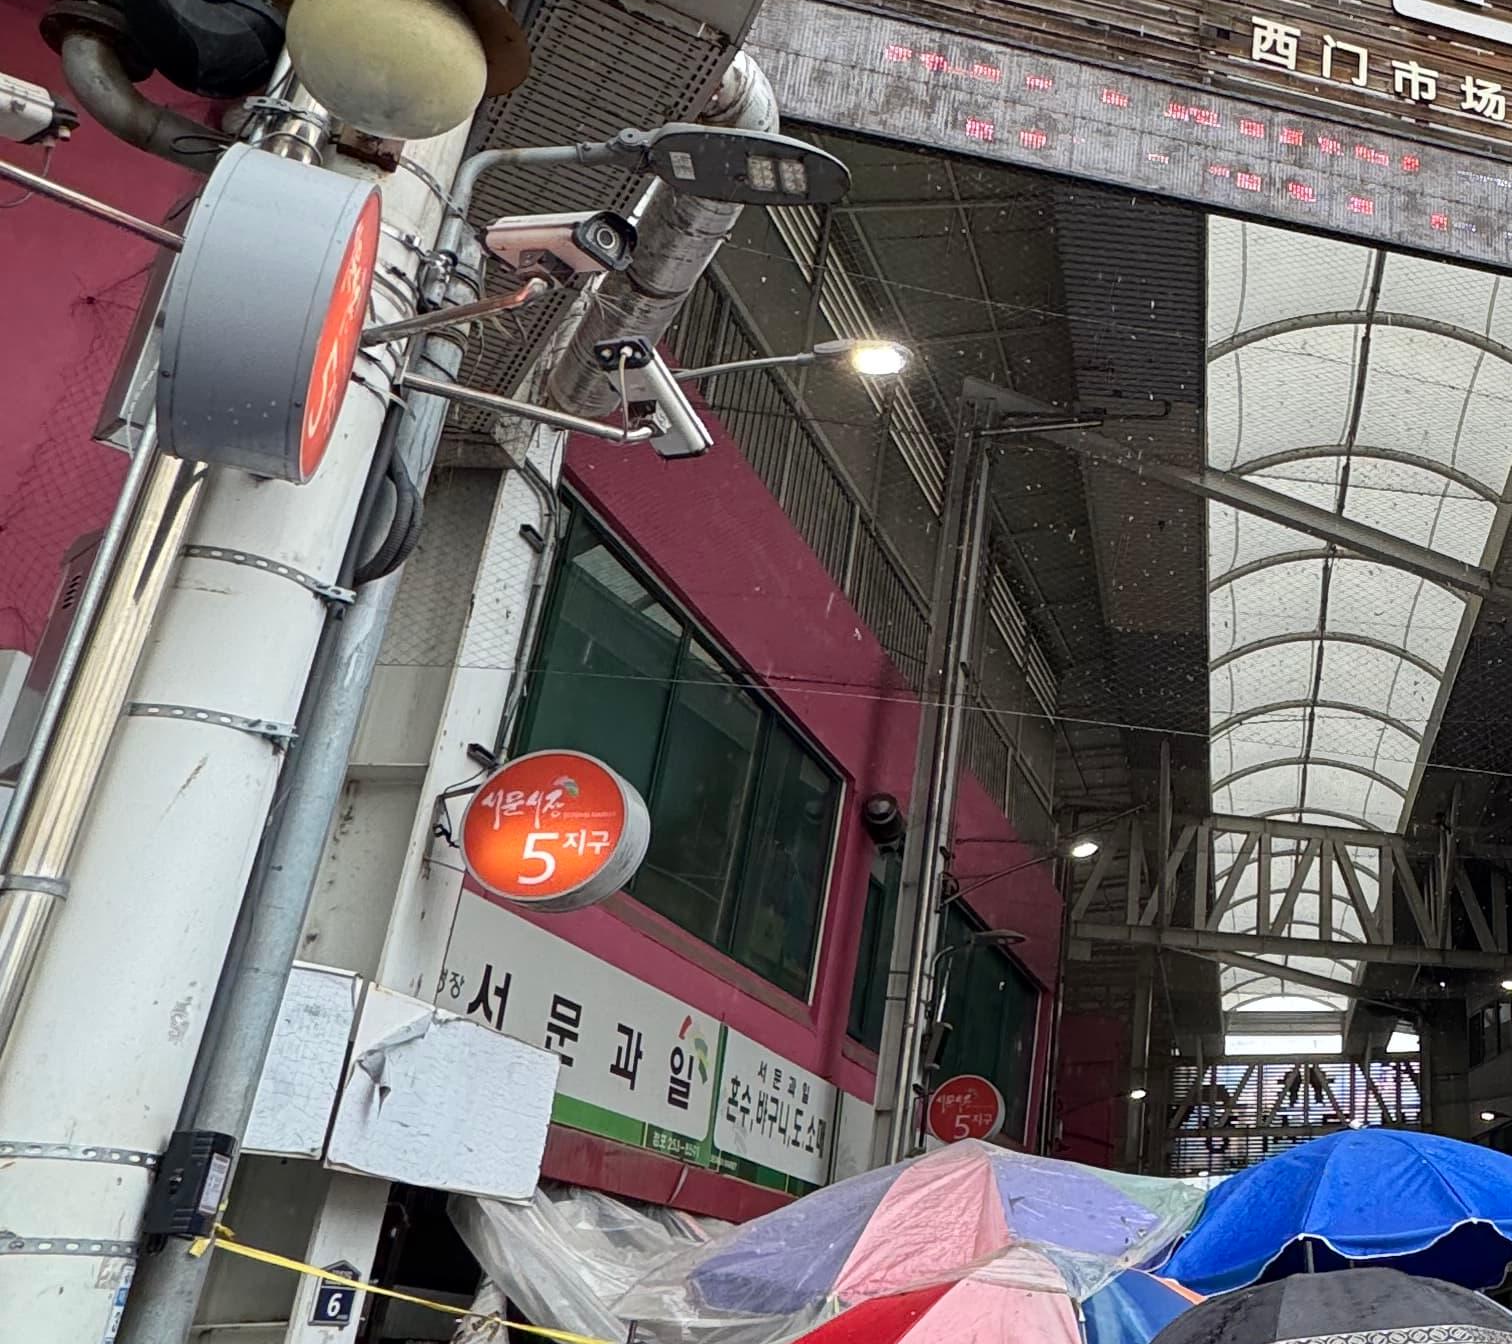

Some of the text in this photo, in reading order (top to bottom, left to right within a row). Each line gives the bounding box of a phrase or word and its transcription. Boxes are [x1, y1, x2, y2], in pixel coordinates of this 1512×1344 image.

[1250, 16, 1506, 122] 西门市场
[467, 963, 695, 1111] 서문과일
[326, 1292, 343, 1317] 6
